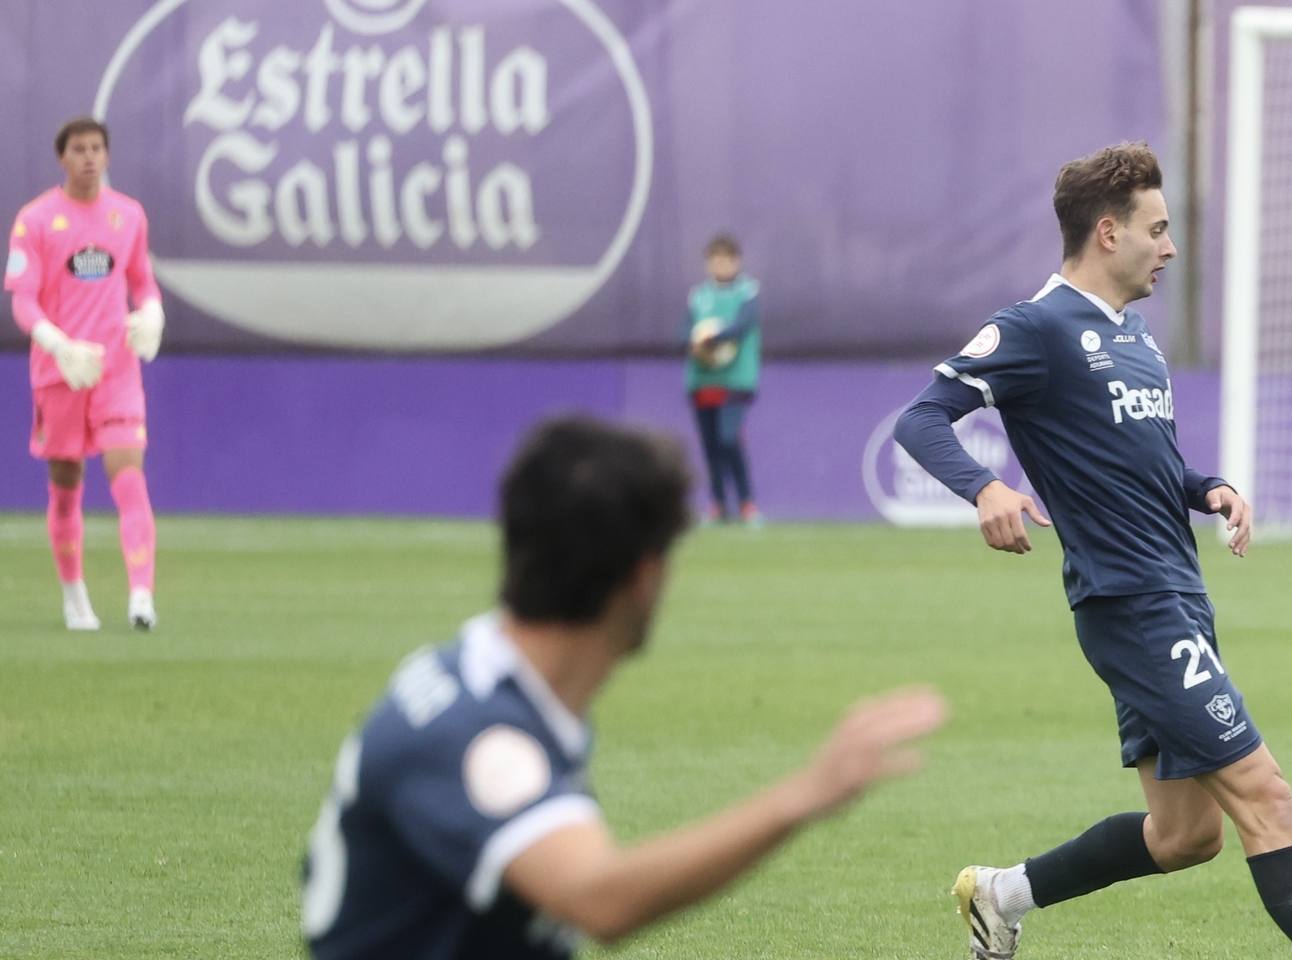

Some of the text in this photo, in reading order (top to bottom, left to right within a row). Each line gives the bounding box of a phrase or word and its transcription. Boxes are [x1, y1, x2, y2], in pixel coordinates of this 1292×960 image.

[183, 16, 550, 135] Estrella
[195, 129, 542, 251] Galicia
[1170, 634, 1225, 690] 21
